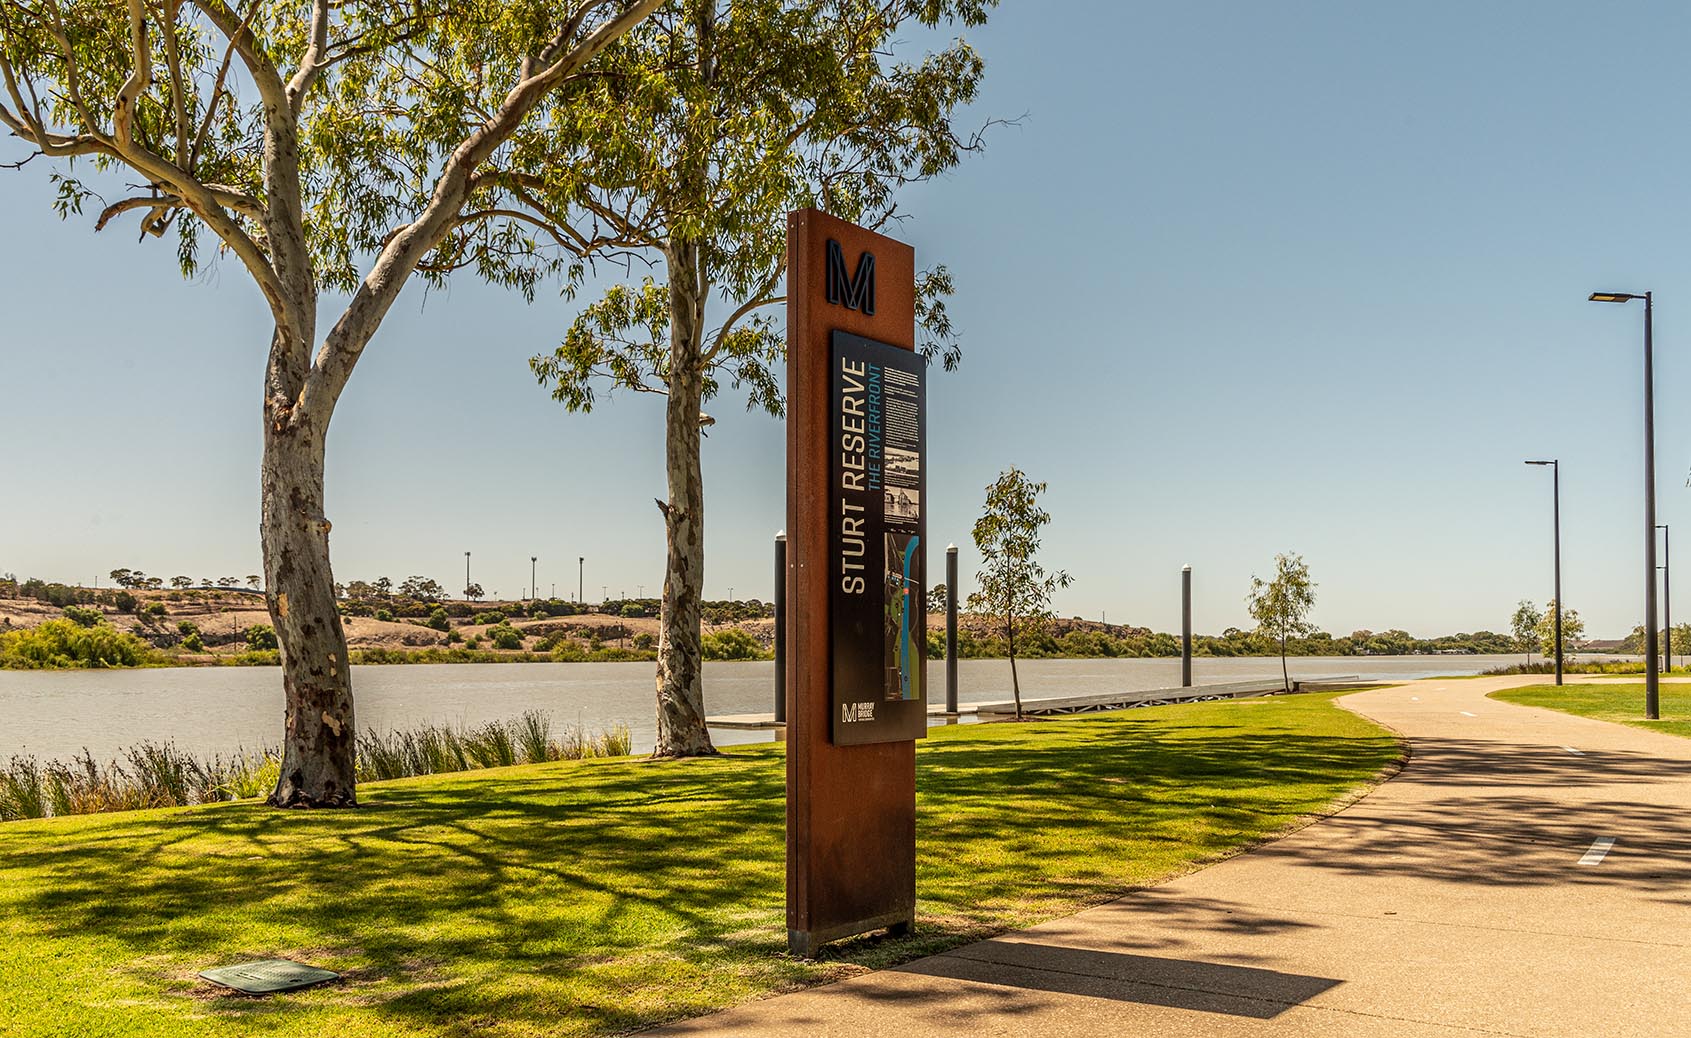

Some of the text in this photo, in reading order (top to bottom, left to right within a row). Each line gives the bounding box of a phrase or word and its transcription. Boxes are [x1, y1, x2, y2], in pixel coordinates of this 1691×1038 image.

[842, 357, 865, 594] STURT RESERVE
[868, 362, 881, 491] THE RIVERFRONT
